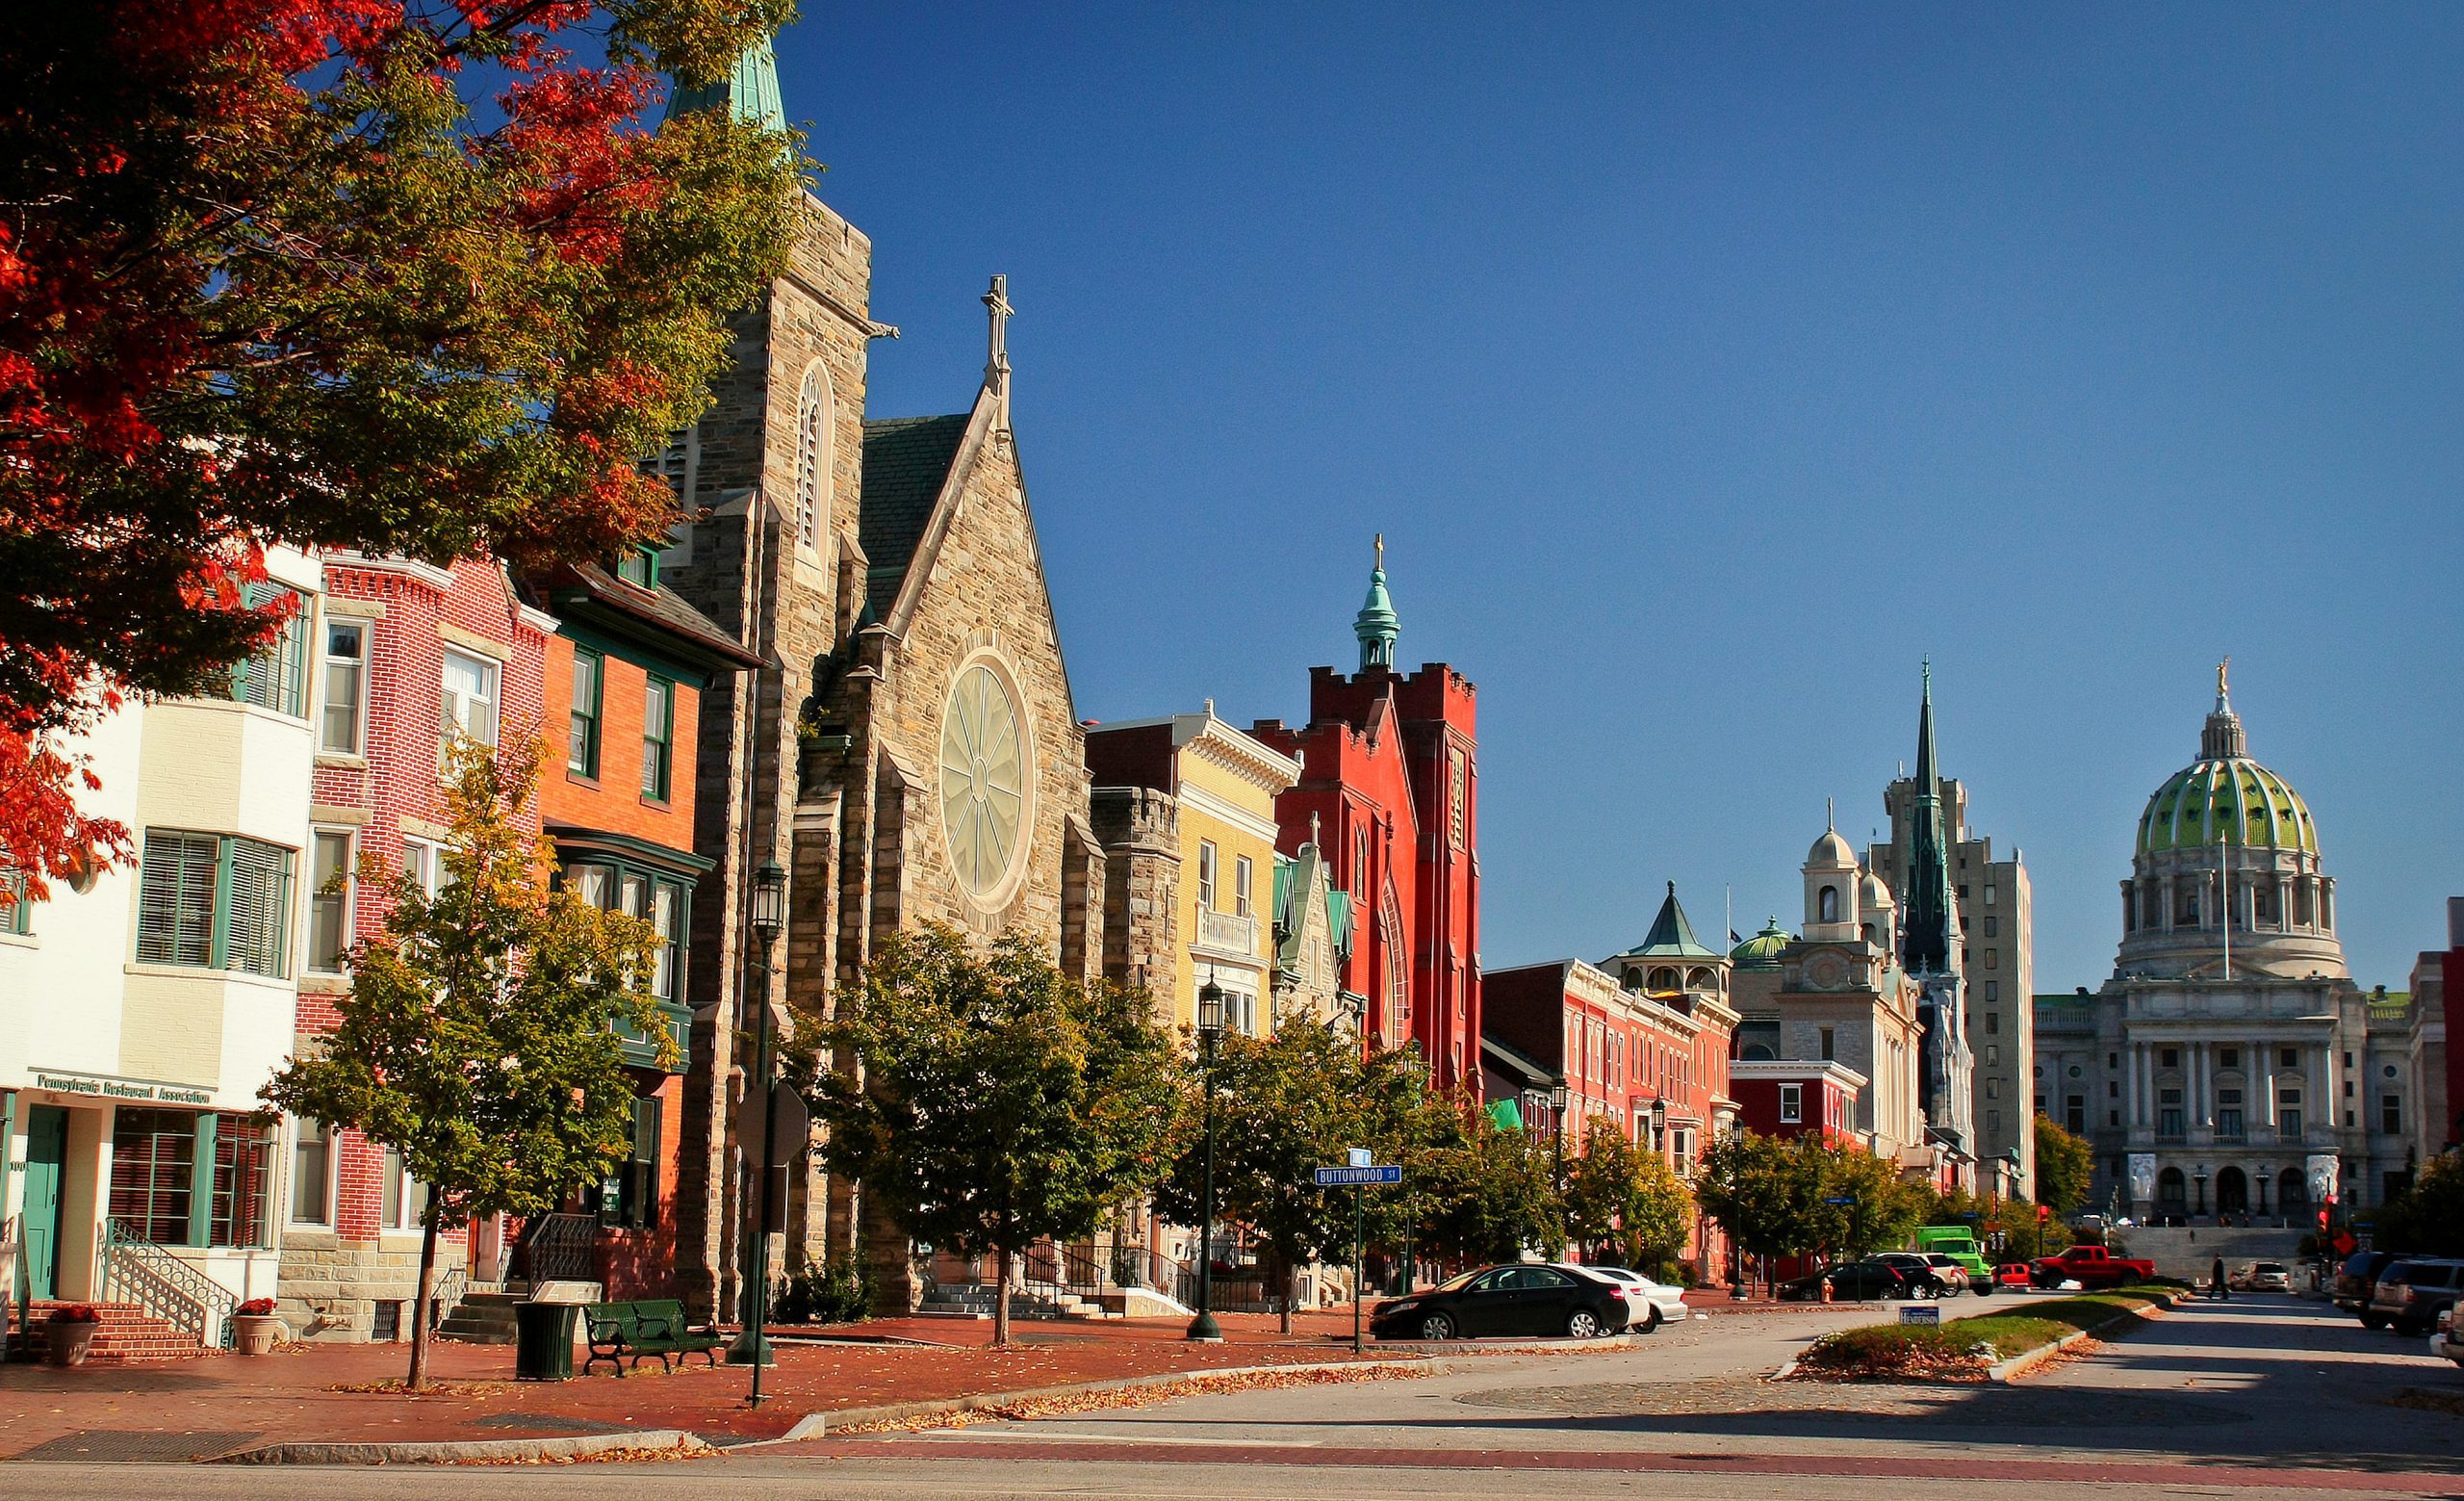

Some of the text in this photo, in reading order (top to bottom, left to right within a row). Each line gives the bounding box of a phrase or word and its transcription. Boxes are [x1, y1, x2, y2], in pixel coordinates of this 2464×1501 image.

[38, 1074, 210, 1104] Pennsylvania Restaurant Association
[1320, 1169, 1396, 1183] BUTTONWOOD ST
